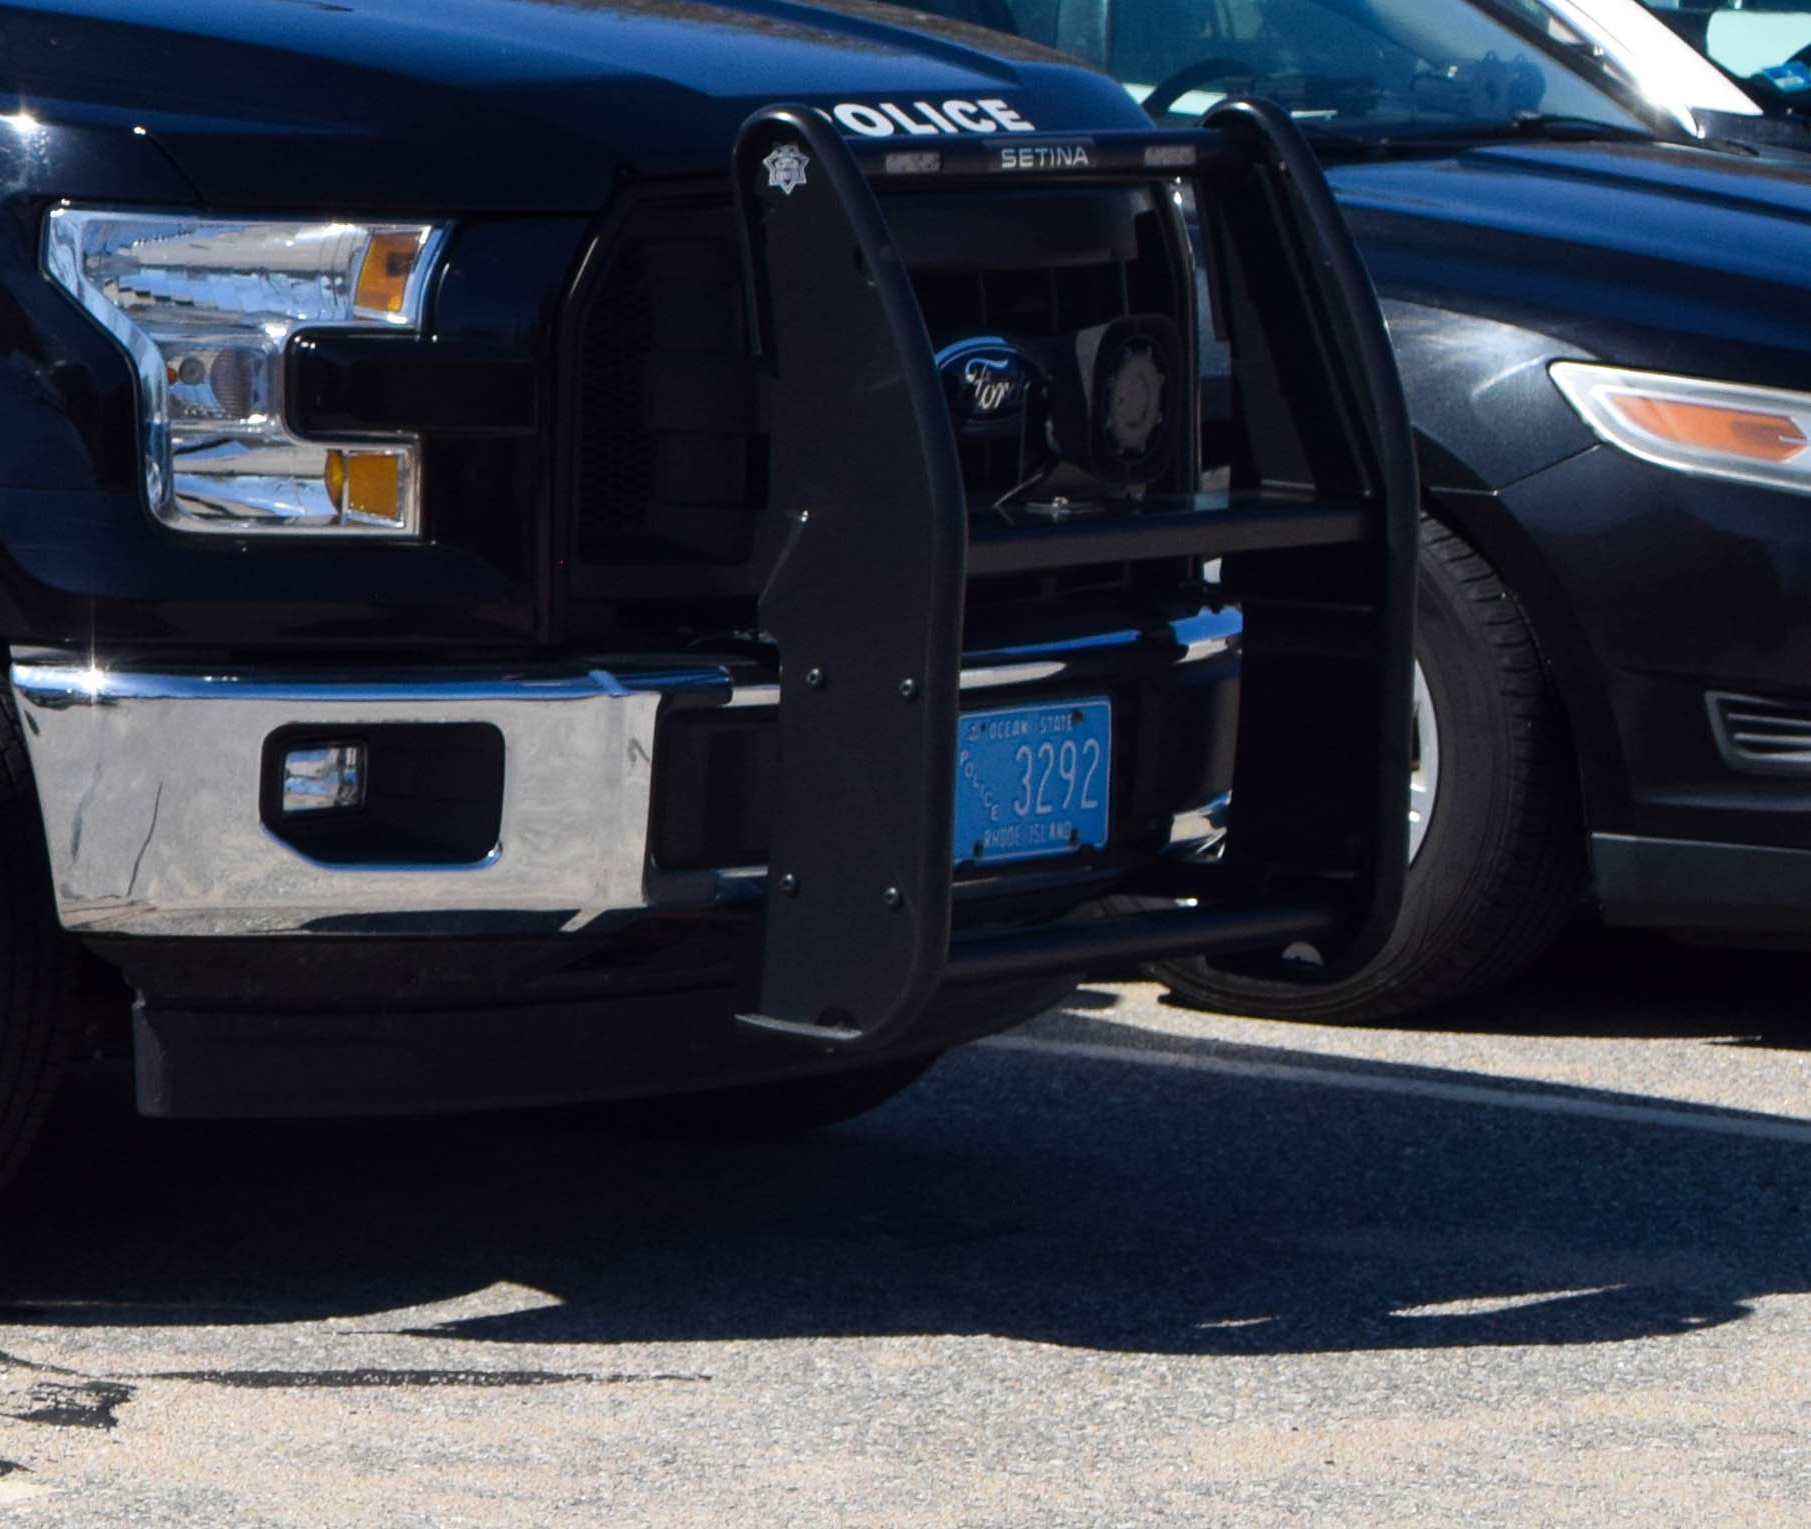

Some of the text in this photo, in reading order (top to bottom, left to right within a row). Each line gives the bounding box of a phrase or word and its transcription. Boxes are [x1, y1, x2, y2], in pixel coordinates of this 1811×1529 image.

[819, 98, 1036, 137] OLICE
[1000, 146, 1090, 169] SETINA
[964, 357, 1032, 410] For
[988, 713, 1074, 740] OCEAN STATE
[960, 749, 1000, 821] POLICE
[1013, 737, 1101, 817] 3292
[983, 819, 1073, 849] RHODE ISLAND
